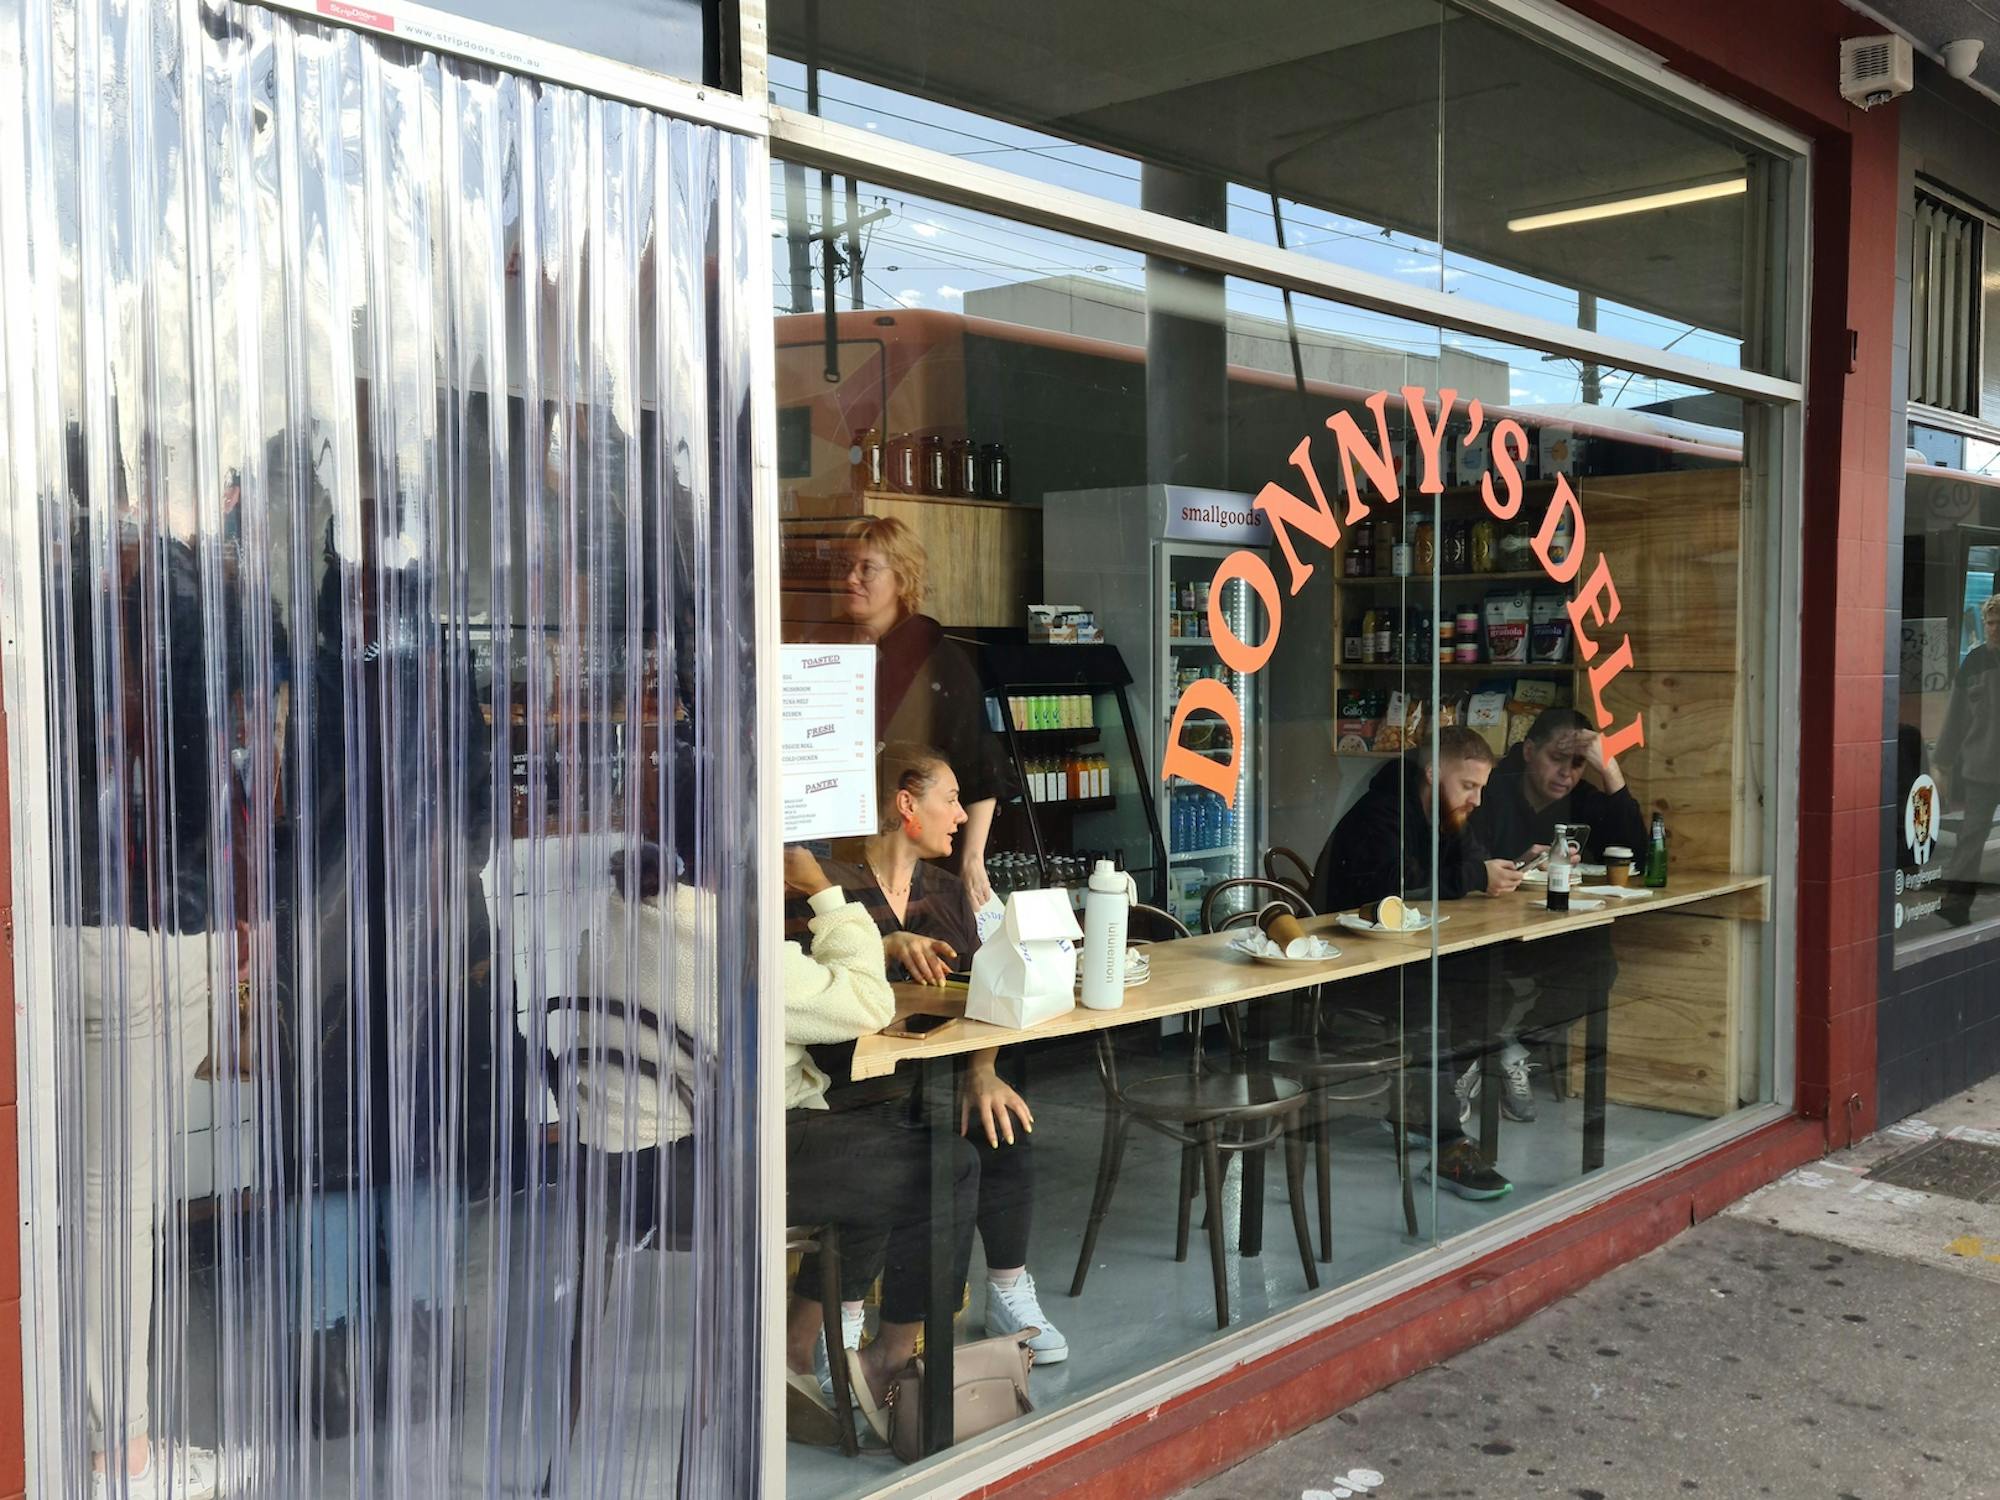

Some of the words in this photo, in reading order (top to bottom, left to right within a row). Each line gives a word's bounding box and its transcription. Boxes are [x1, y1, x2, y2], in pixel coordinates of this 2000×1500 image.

[404, 24, 540, 68] www.stripdoors.com.au
[1181, 504, 1262, 528] smallgoods
[1162, 386, 1530, 810] DONNY'S
[1530, 471, 1646, 768] DELI
[1489, 626, 1524, 638] granola
[801, 654, 841, 669] TOASTED
[806, 723, 836, 739] FRESH
[805, 777, 839, 794] PANTRY
[1105, 922, 1120, 984] lululemon
